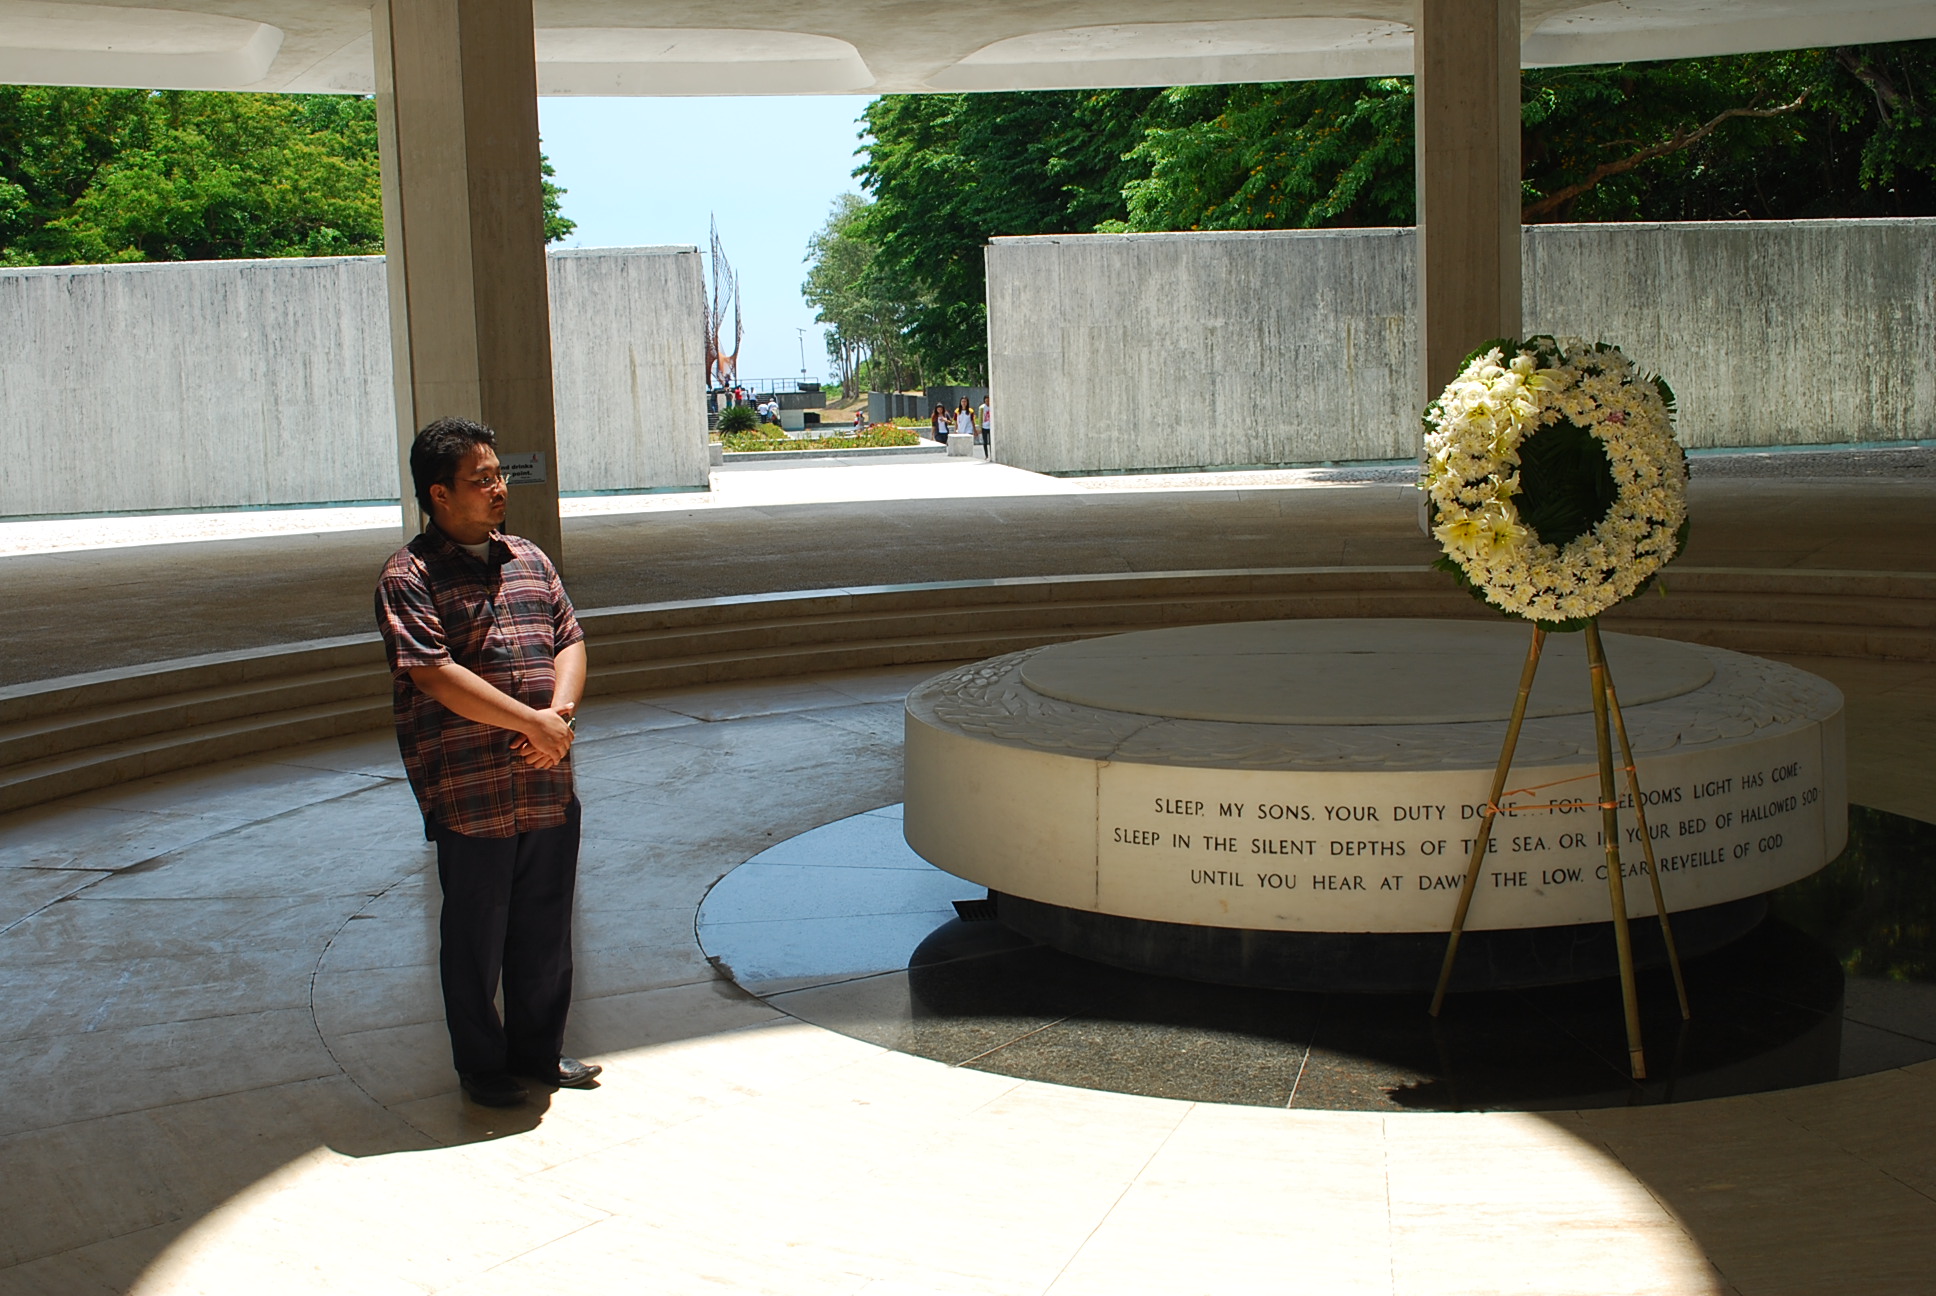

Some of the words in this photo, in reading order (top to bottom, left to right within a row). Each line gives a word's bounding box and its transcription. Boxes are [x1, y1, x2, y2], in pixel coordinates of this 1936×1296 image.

[1219, 802, 1245, 818] MY
[1324, 805, 1380, 822] YOUR
[1393, 804, 1447, 822] DUTY
[1549, 798, 1586, 815] FOR
[1693, 778, 1733, 799] LIGHT
[1741, 771, 1765, 790] HAS
[1113, 827, 1161, 846] SLEEP
[1172, 833, 1192, 849] IN
[1203, 835, 1238, 853] THE
[1251, 838, 1317, 856] SILENT
[1330, 840, 1407, 857] DEPTHS
[1419, 839, 1447, 857] OF
[1558, 833, 1587, 849] OR
[1679, 818, 1707, 836] BED
[1715, 812, 1733, 829] OF
[1741, 796, 1797, 824] HALLOWED
[1190, 869, 1245, 888] UNTIL
[1257, 873, 1297, 890] YOU
[1312, 875, 1367, 891] HEAR
[1379, 875, 1404, 891] AT
[1491, 871, 1528, 888] THE
[1595, 860, 1651, 881] CEAR
[1660, 847, 1726, 873] REVEILLE
[1733, 842, 1750, 859] OF
[1758, 833, 1784, 853] GOD
